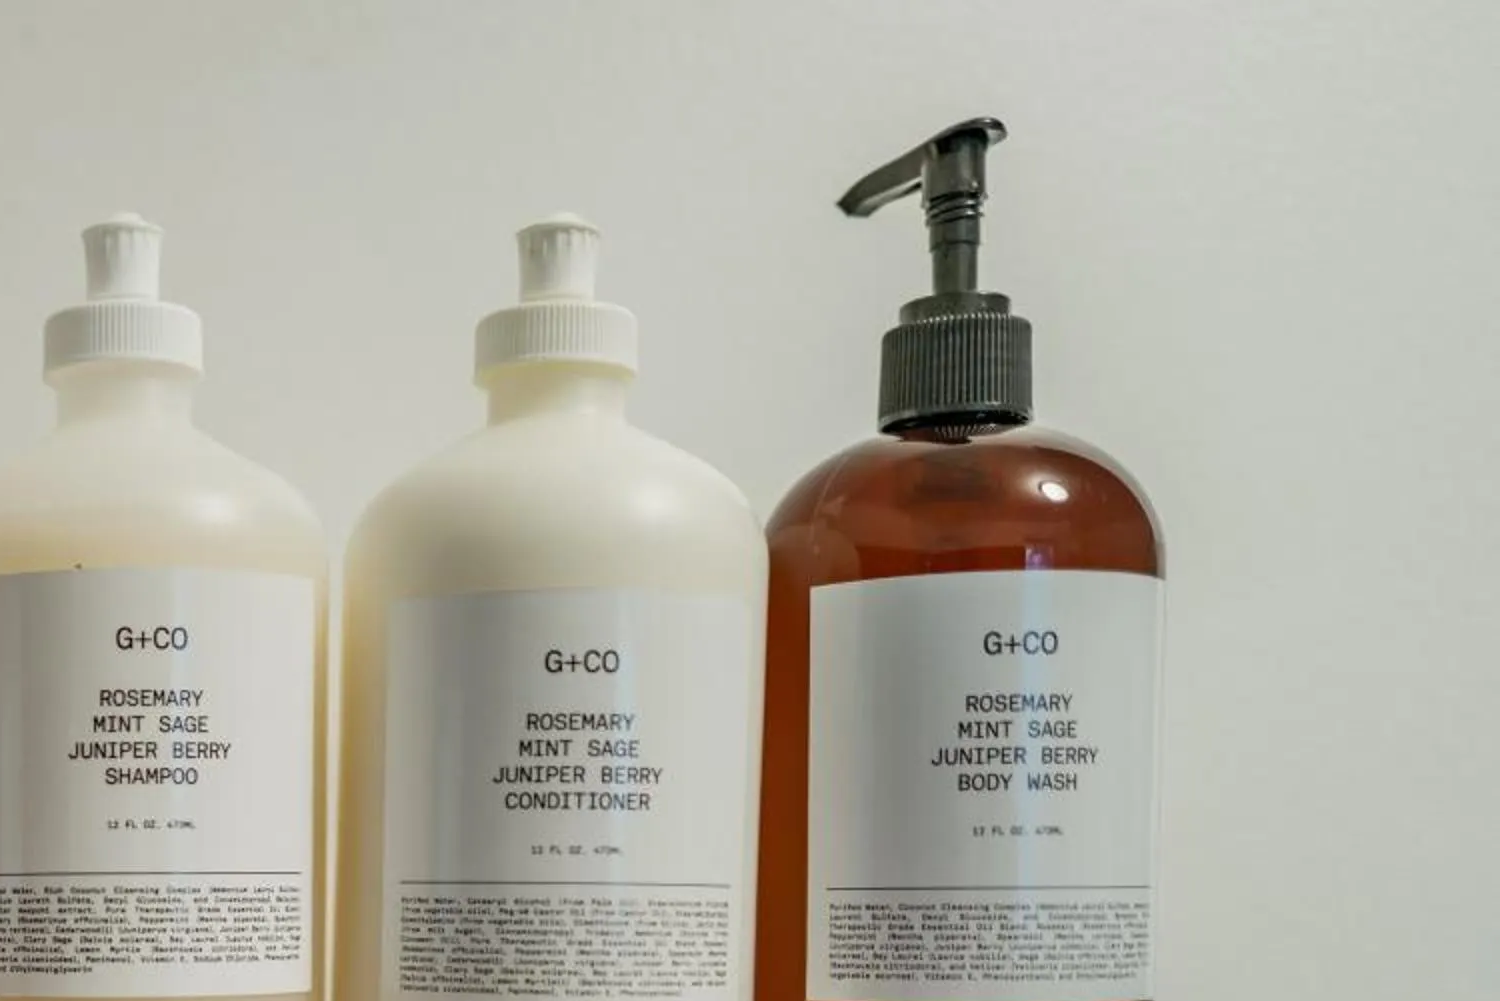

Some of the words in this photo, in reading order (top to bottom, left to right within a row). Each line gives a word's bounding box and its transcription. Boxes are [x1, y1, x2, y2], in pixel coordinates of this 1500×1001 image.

[116, 627, 189, 650] G+CO
[983, 631, 1059, 655] G+CO
[544, 650, 620, 673] G+CO
[99, 689, 204, 707] ROSEMARY
[965, 694, 1073, 713] ROSEMARY
[93, 715, 145, 733] MINT
[159, 715, 210, 733] SAGE
[526, 713, 635, 731] ROSEMARY
[957, 720, 1013, 739] MINT
[1027, 720, 1078, 739] SAGE
[67, 741, 158, 759] JUNIPER
[171, 741, 232, 759] BERRY
[518, 739, 573, 757] MINT
[587, 739, 641, 758] SAGE
[931, 747, 1028, 766] JUNIPER
[1041, 747, 1102, 765] BERRY
[105, 767, 200, 785] SHAMPOO
[492, 765, 586, 784] JUNIPER
[600, 766, 664, 784] BERRY
[957, 773, 1013, 791] BODY
[1027, 773, 1078, 791] WASH
[504, 791, 652, 811] CONDITIONER
